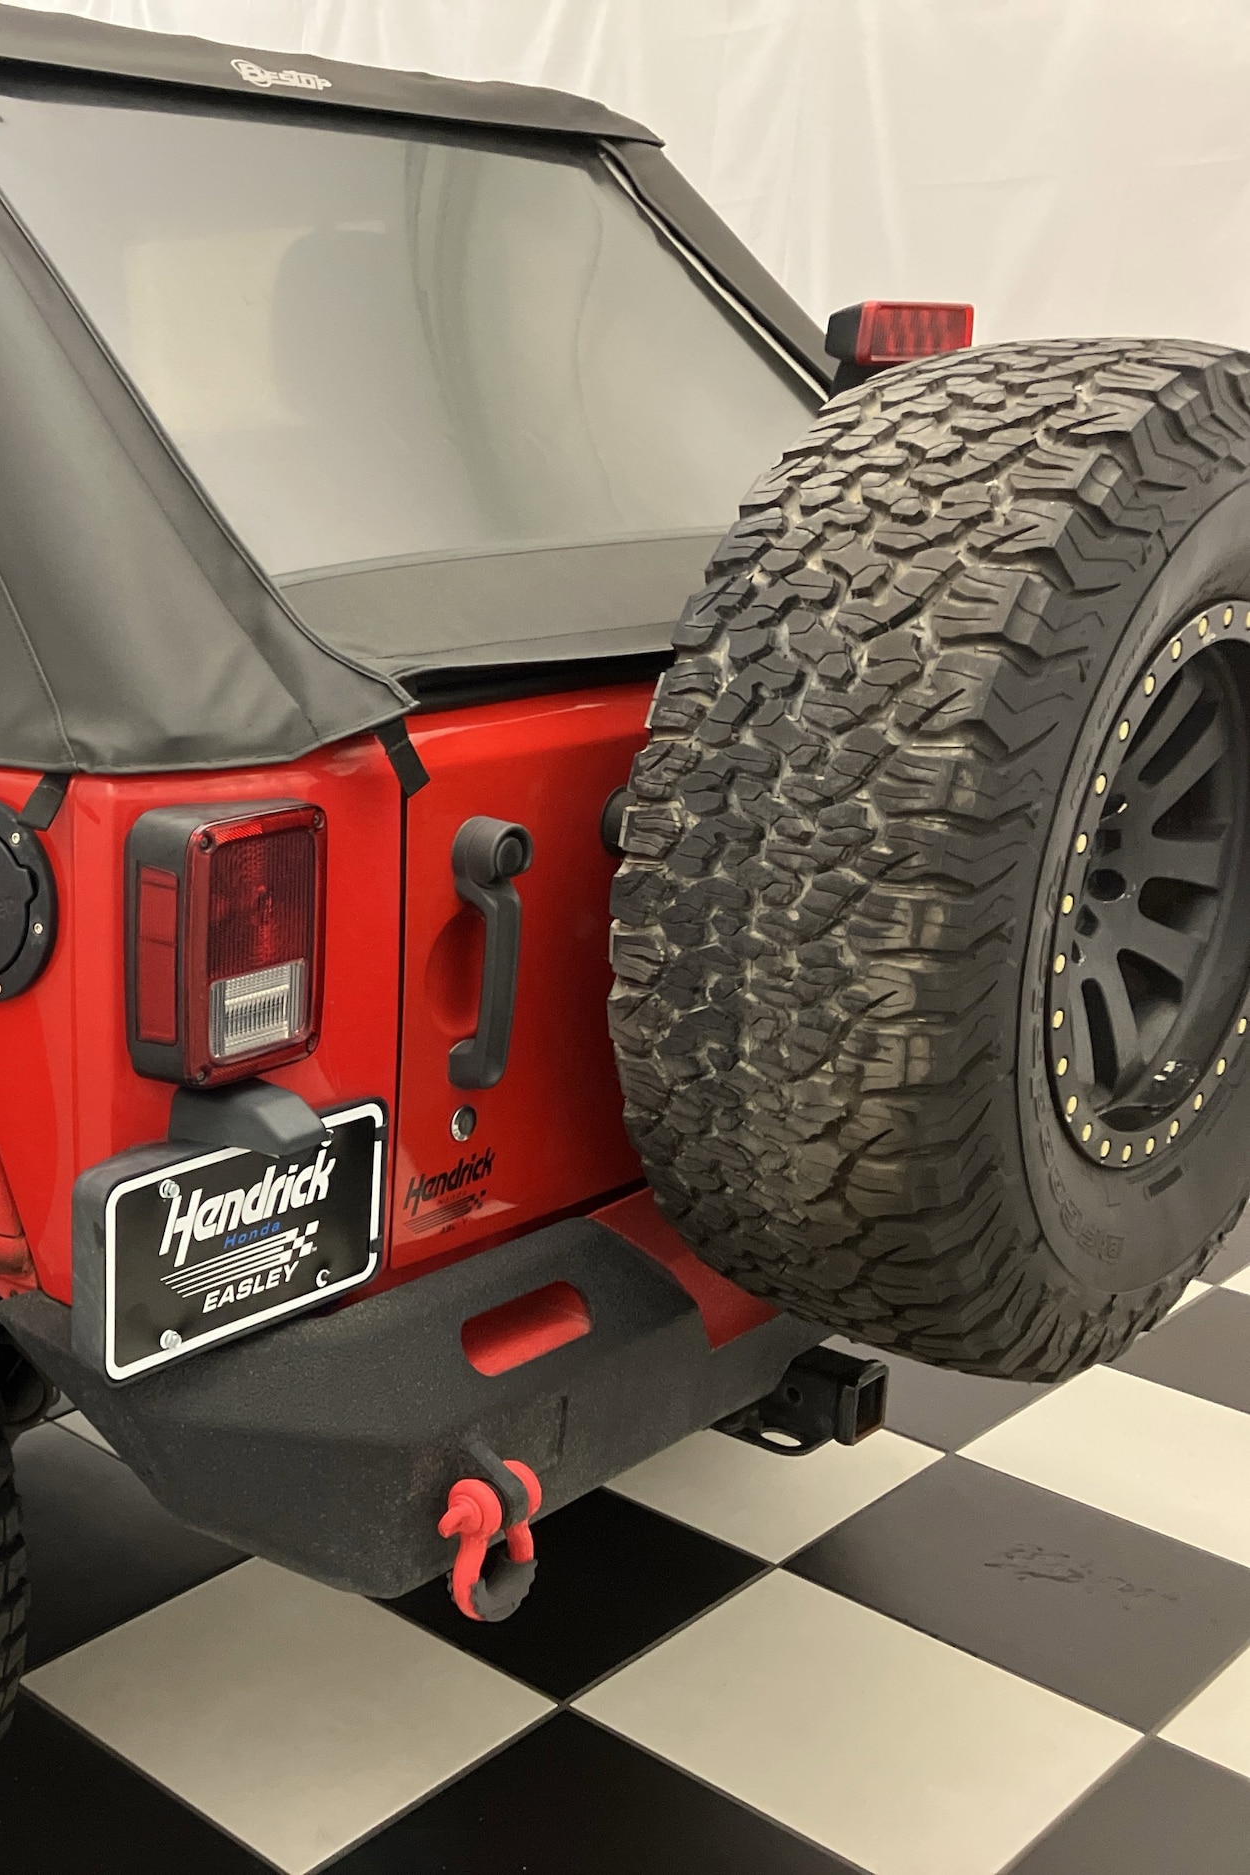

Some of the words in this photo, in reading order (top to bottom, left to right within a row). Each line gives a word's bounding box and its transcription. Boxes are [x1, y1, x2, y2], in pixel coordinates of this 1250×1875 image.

[159, 1148, 337, 1268] Hendrick
[402, 1147, 496, 1217] Hendrick
[223, 1219, 282, 1251] Honda
[202, 1261, 299, 1314] EASLEY
